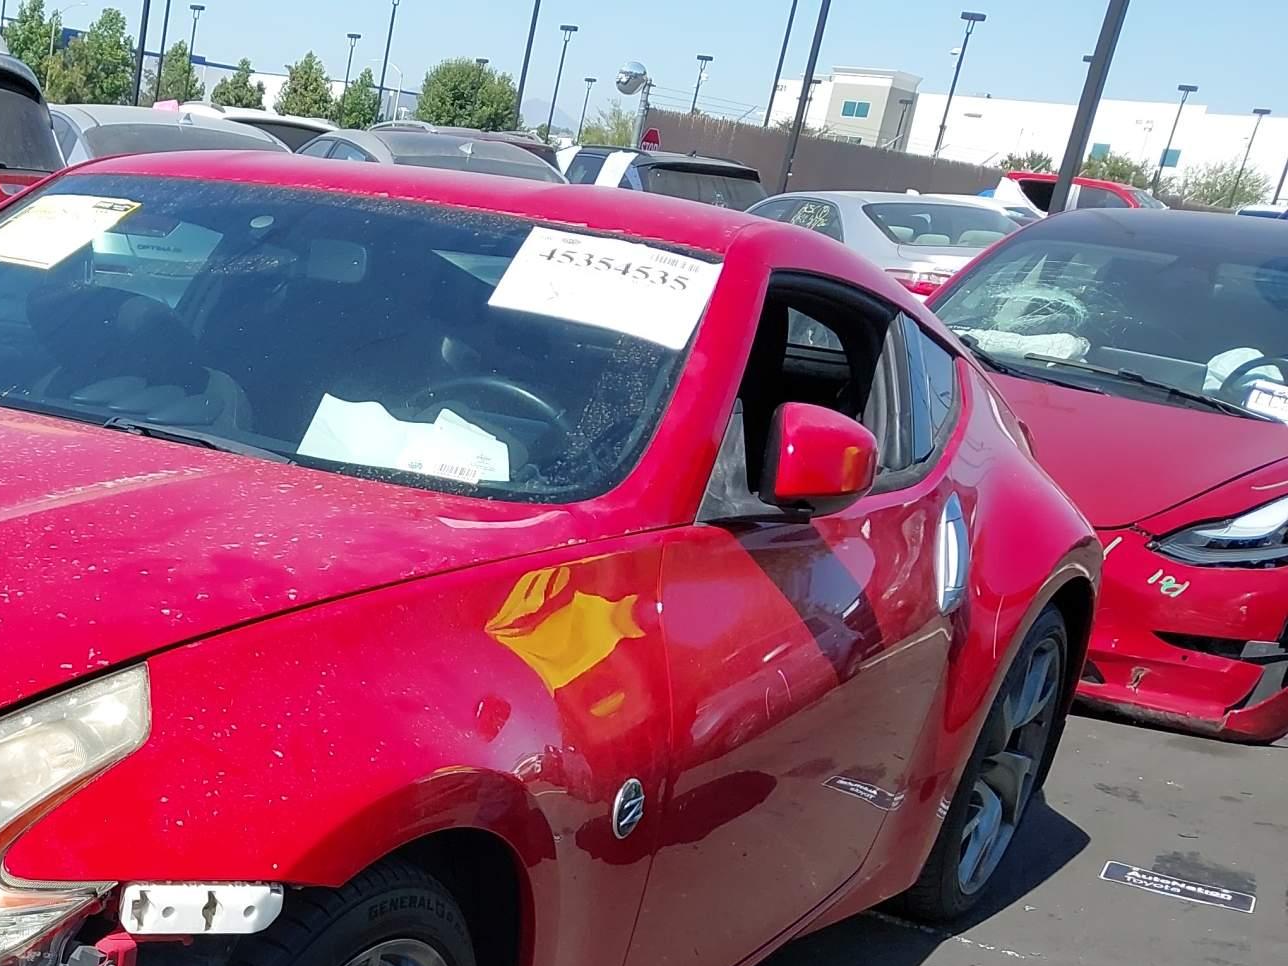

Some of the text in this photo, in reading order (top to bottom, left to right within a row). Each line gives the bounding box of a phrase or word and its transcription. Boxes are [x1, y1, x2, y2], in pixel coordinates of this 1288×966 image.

[538, 247, 690, 292] 45354535
[1124, 875, 1181, 893] Toyota
[1126, 869, 1233, 901] AutoNation
[368, 895, 434, 920] GENERAL
